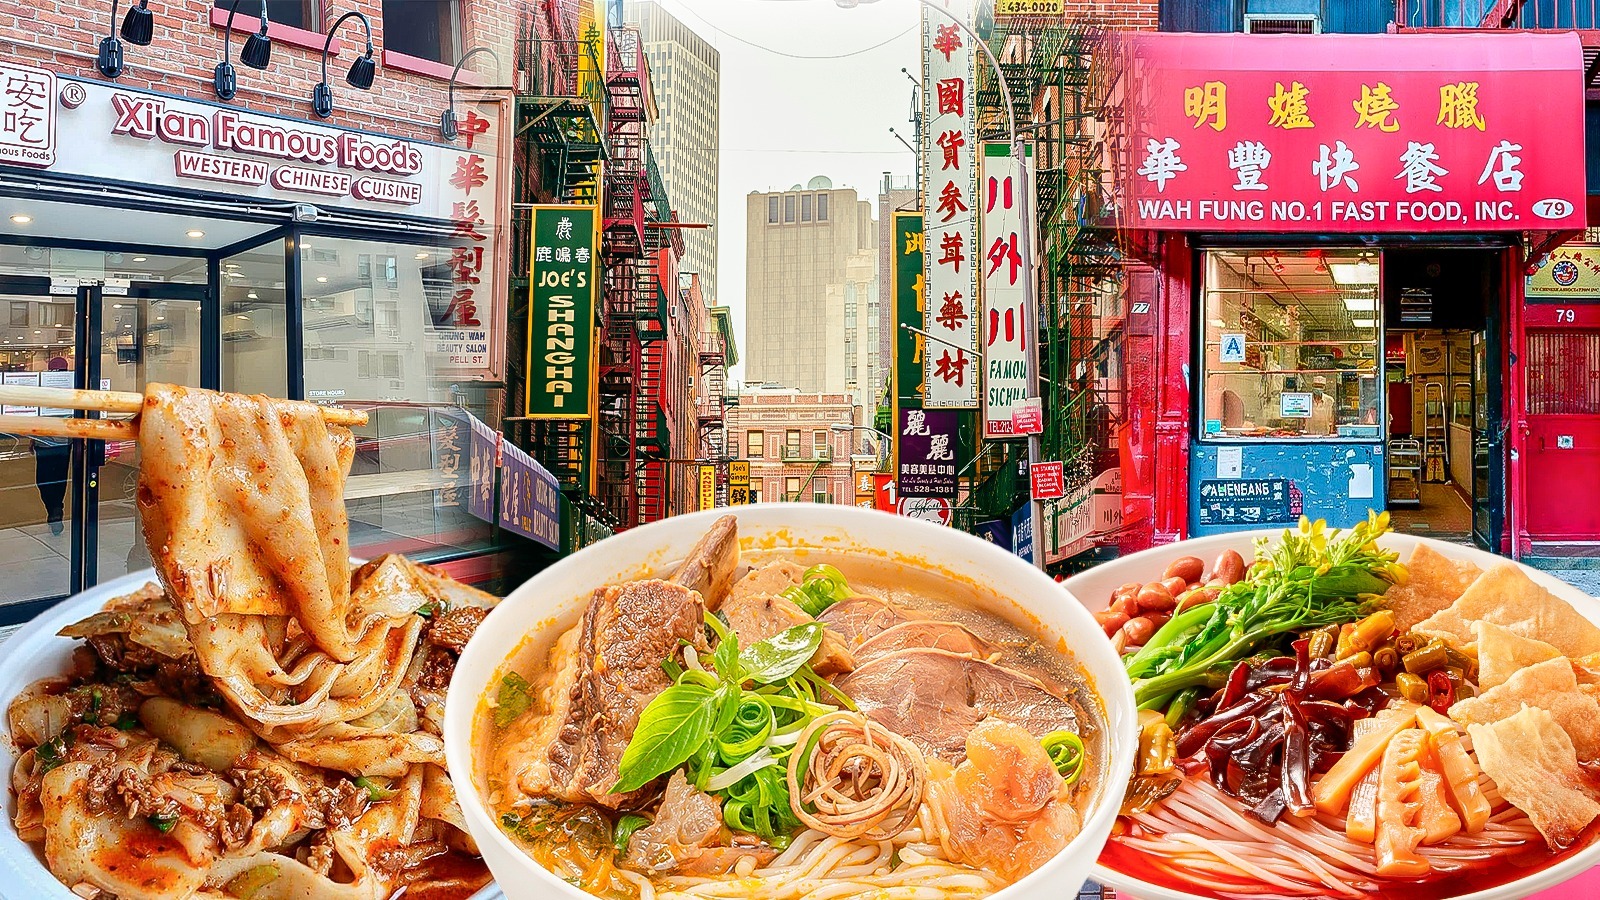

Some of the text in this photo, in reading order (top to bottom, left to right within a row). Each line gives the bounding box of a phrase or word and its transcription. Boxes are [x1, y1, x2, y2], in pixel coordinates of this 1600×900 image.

[1008, 2, 1058, 13] 434-0020
[116, 96, 420, 172] Xi'an Famous Foods
[0, 147, 51, 160] ous Foods
[1136, 137, 1524, 194] 華豐快餐店
[182, 154, 419, 200] WESTERN CHINESE CUISINE
[933, 0, 968, 387] 華國貨参茸藥材
[1138, 201, 1565, 223] WAH FUNG NO.1 FAST FOOD, INC. 79
[539, 269, 586, 287] JOE'S
[1133, 304, 1148, 312] 77
[1556, 309, 1575, 322] 79
[469, 332, 485, 340] WAH
[437, 344, 486, 353] BEAUTY SALON
[545, 296, 575, 407] SHANGHAI
[1226, 338, 1240, 354] A
[990, 360, 1026, 379] FAMOU
[731, 473, 748, 481] Ginger
